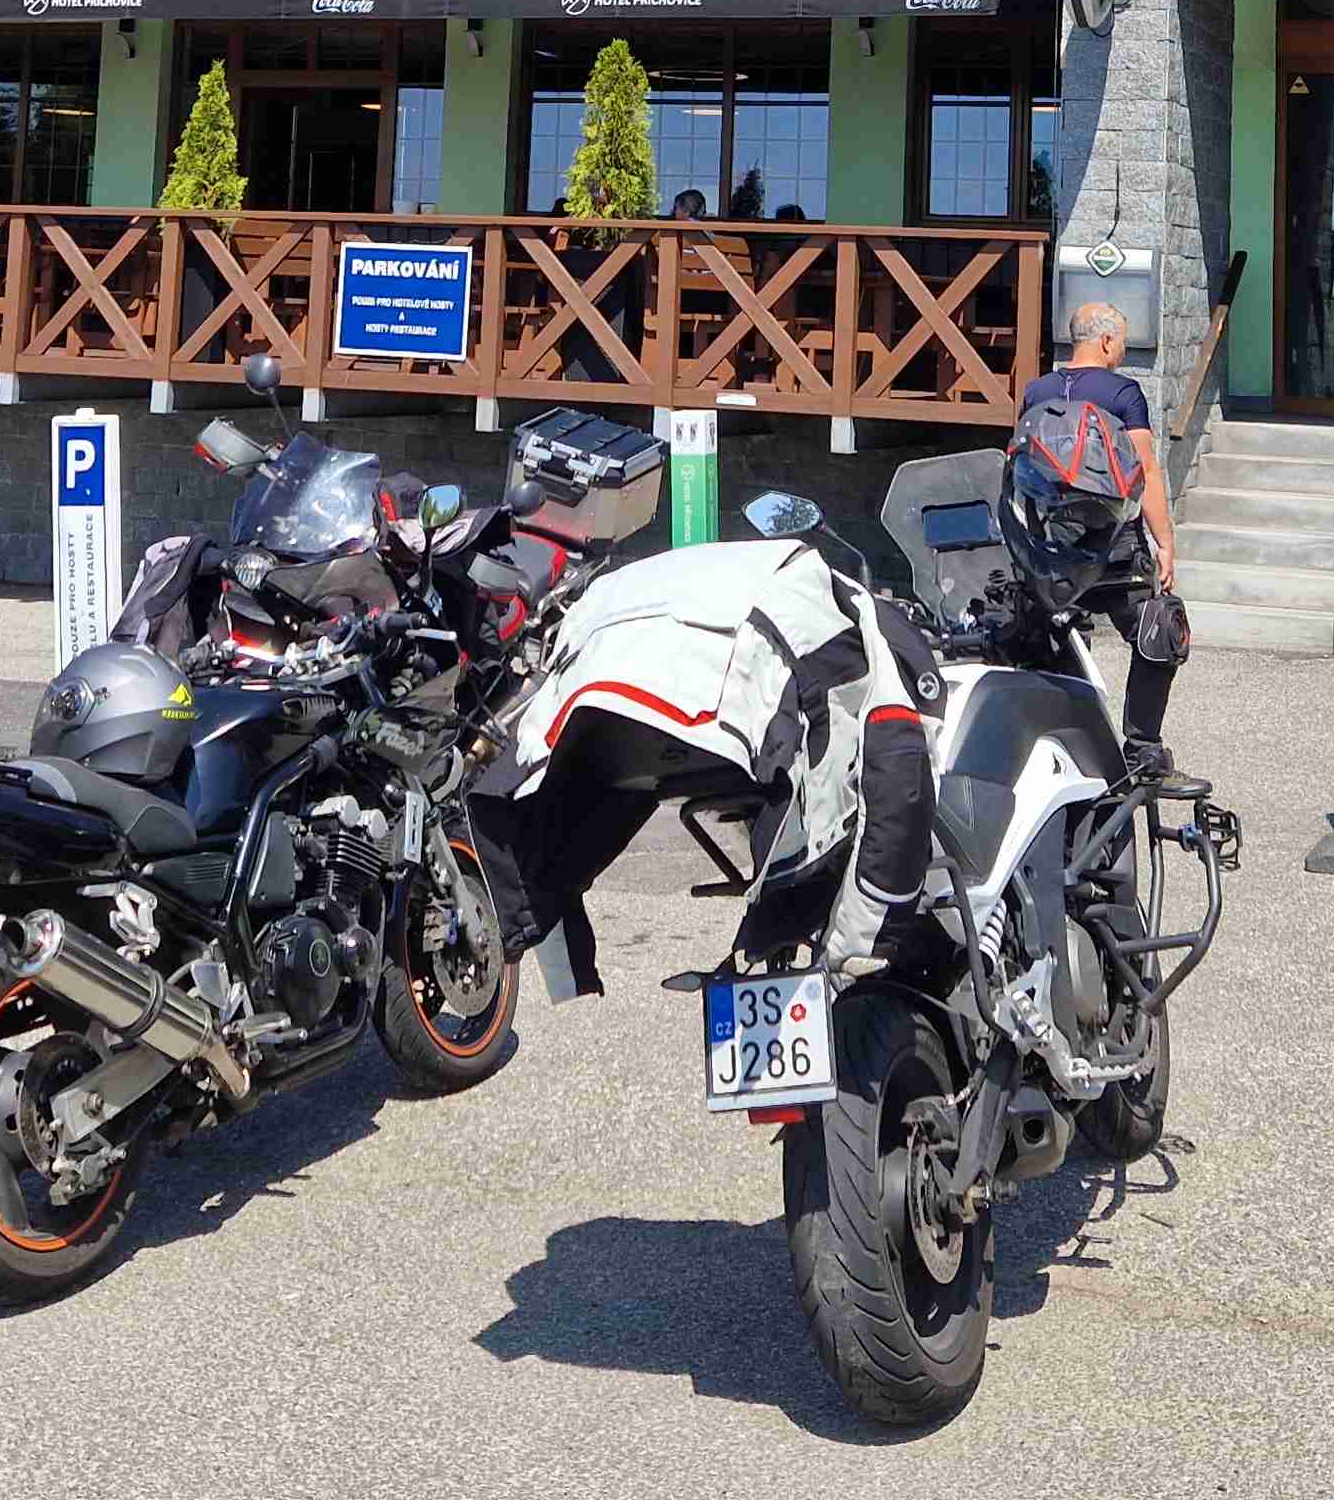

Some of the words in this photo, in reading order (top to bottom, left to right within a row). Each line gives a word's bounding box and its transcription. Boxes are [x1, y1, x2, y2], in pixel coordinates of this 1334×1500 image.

[351, 258, 460, 280] PARKOVÁNÍ
[66, 438, 96, 489] P
[68, 532, 76, 578] HOSTY
[85, 513, 95, 606] RESTAURACE
[69, 615, 79, 657] OUZE
[715, 1021, 732, 1036] CZ
[739, 986, 782, 1029] 3S
[718, 1037, 811, 1084] J286
